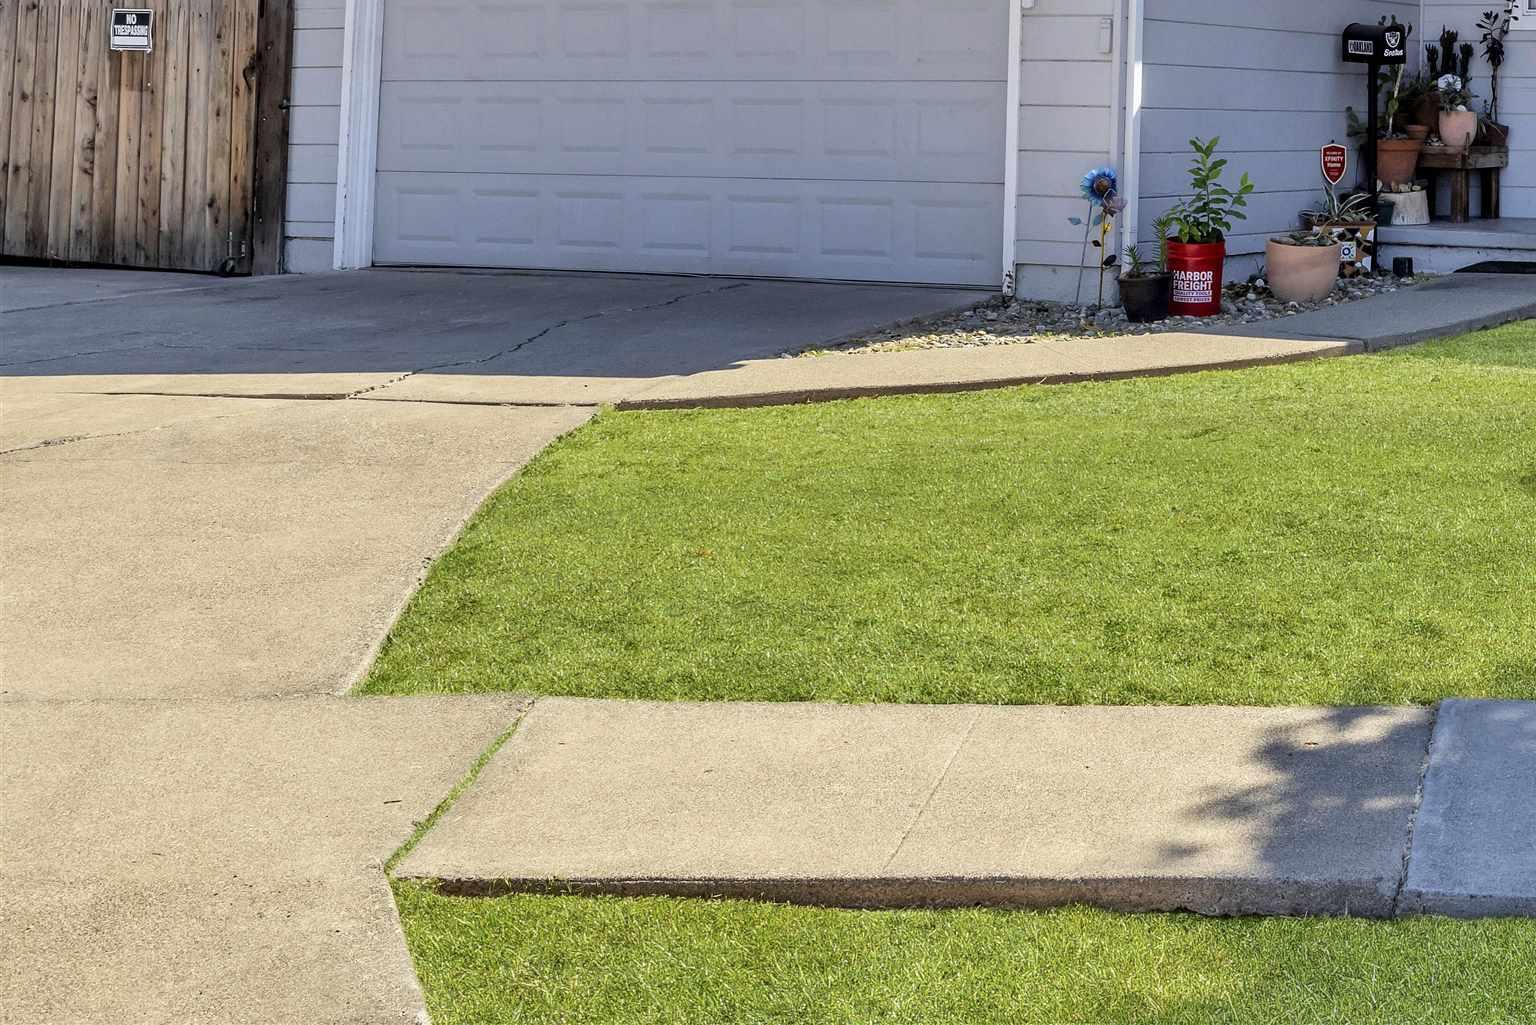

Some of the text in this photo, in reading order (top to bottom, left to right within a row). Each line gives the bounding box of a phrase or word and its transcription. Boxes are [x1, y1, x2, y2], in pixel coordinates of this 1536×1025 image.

[126, 13, 137, 25] NO
[114, 25, 148, 36] TRESPASSING
[1173, 270, 1213, 281] HARBOR
[1173, 280, 1213, 291] FREIGHT
